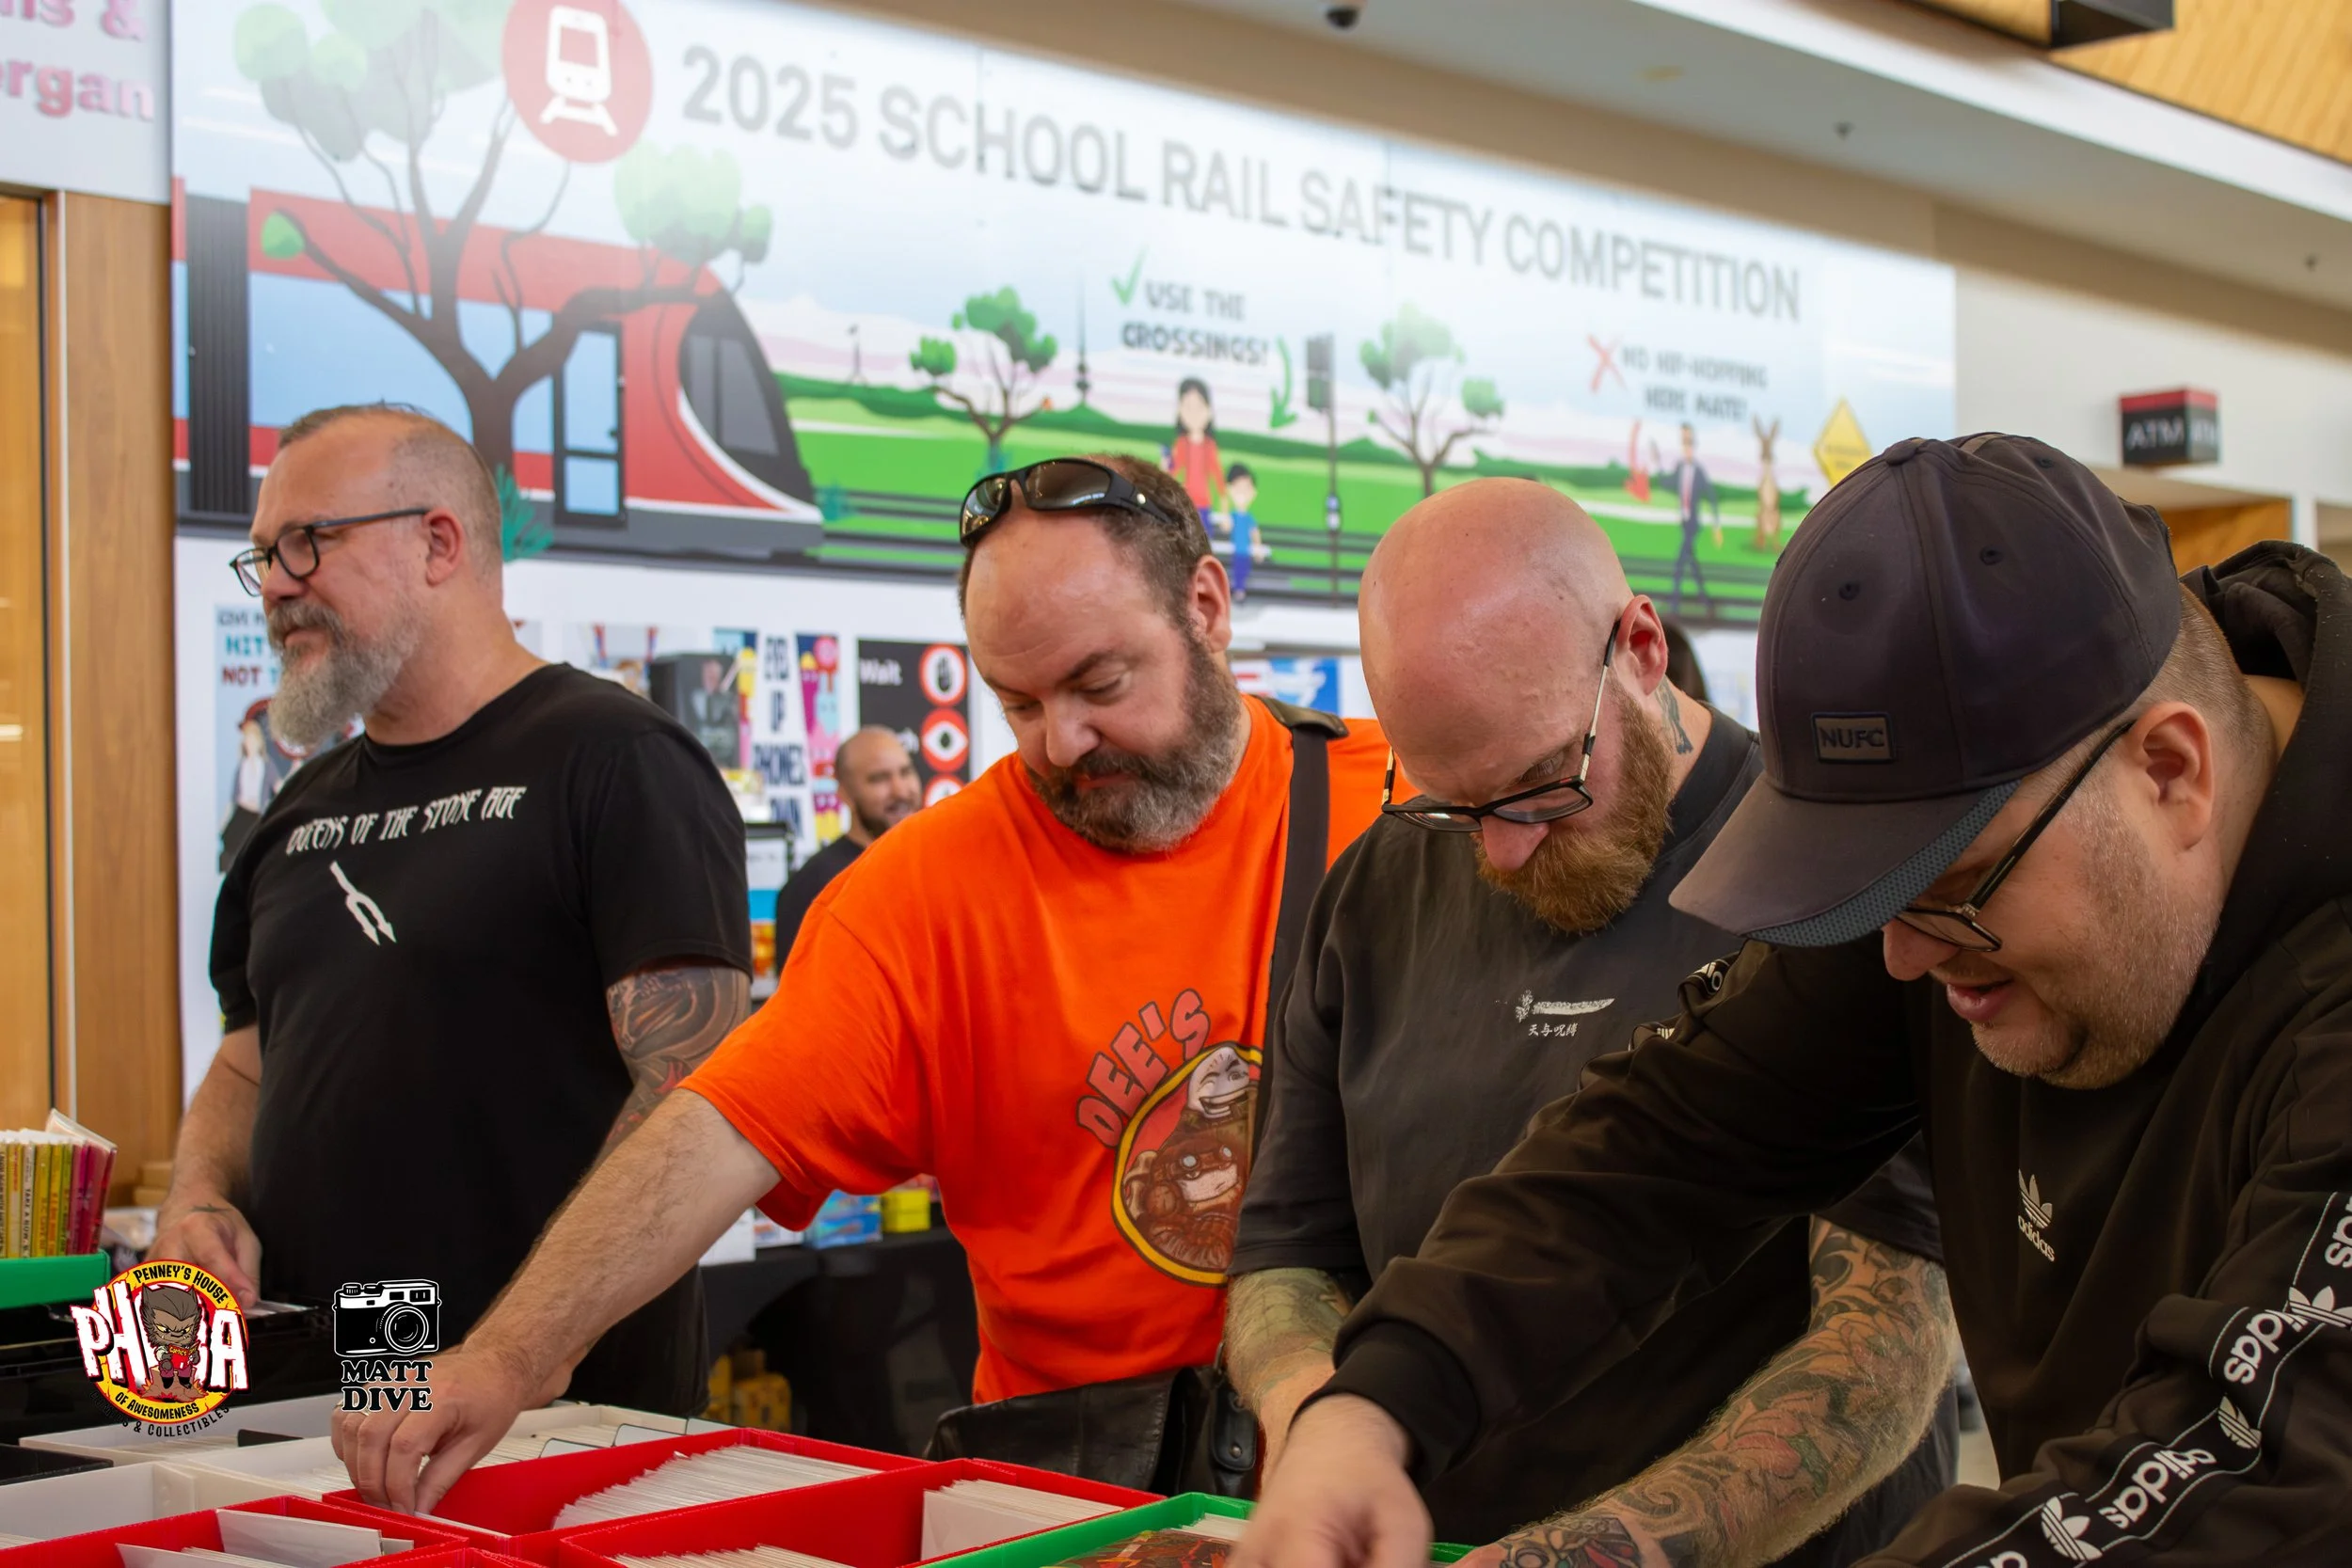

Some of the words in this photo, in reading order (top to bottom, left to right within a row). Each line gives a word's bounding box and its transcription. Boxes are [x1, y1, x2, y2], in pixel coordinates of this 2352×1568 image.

[683, 45, 857, 150] 2025
[879, 86, 1147, 202] SCHOOL
[1162, 140, 1289, 229] RAIL
[1300, 169, 1493, 265] SAFETY
[1505, 214, 1801, 323] COMPETITION
[1146, 280, 1193, 313] USE
[1204, 289, 1246, 321] THE
[1123, 323, 1269, 366] CROSSINGS!
[2125, 416, 2184, 450] ATM
[221, 666, 261, 687] NOT
[1818, 726, 1885, 749] NUFC
[351, 814, 379, 845] OF
[378, 806, 419, 841] THE
[421, 788, 482, 833] STONE
[481, 786, 527, 820] AGE
[1076, 989, 1211, 1148] DEE'S
[2018, 1215, 2055, 1261] adidas
